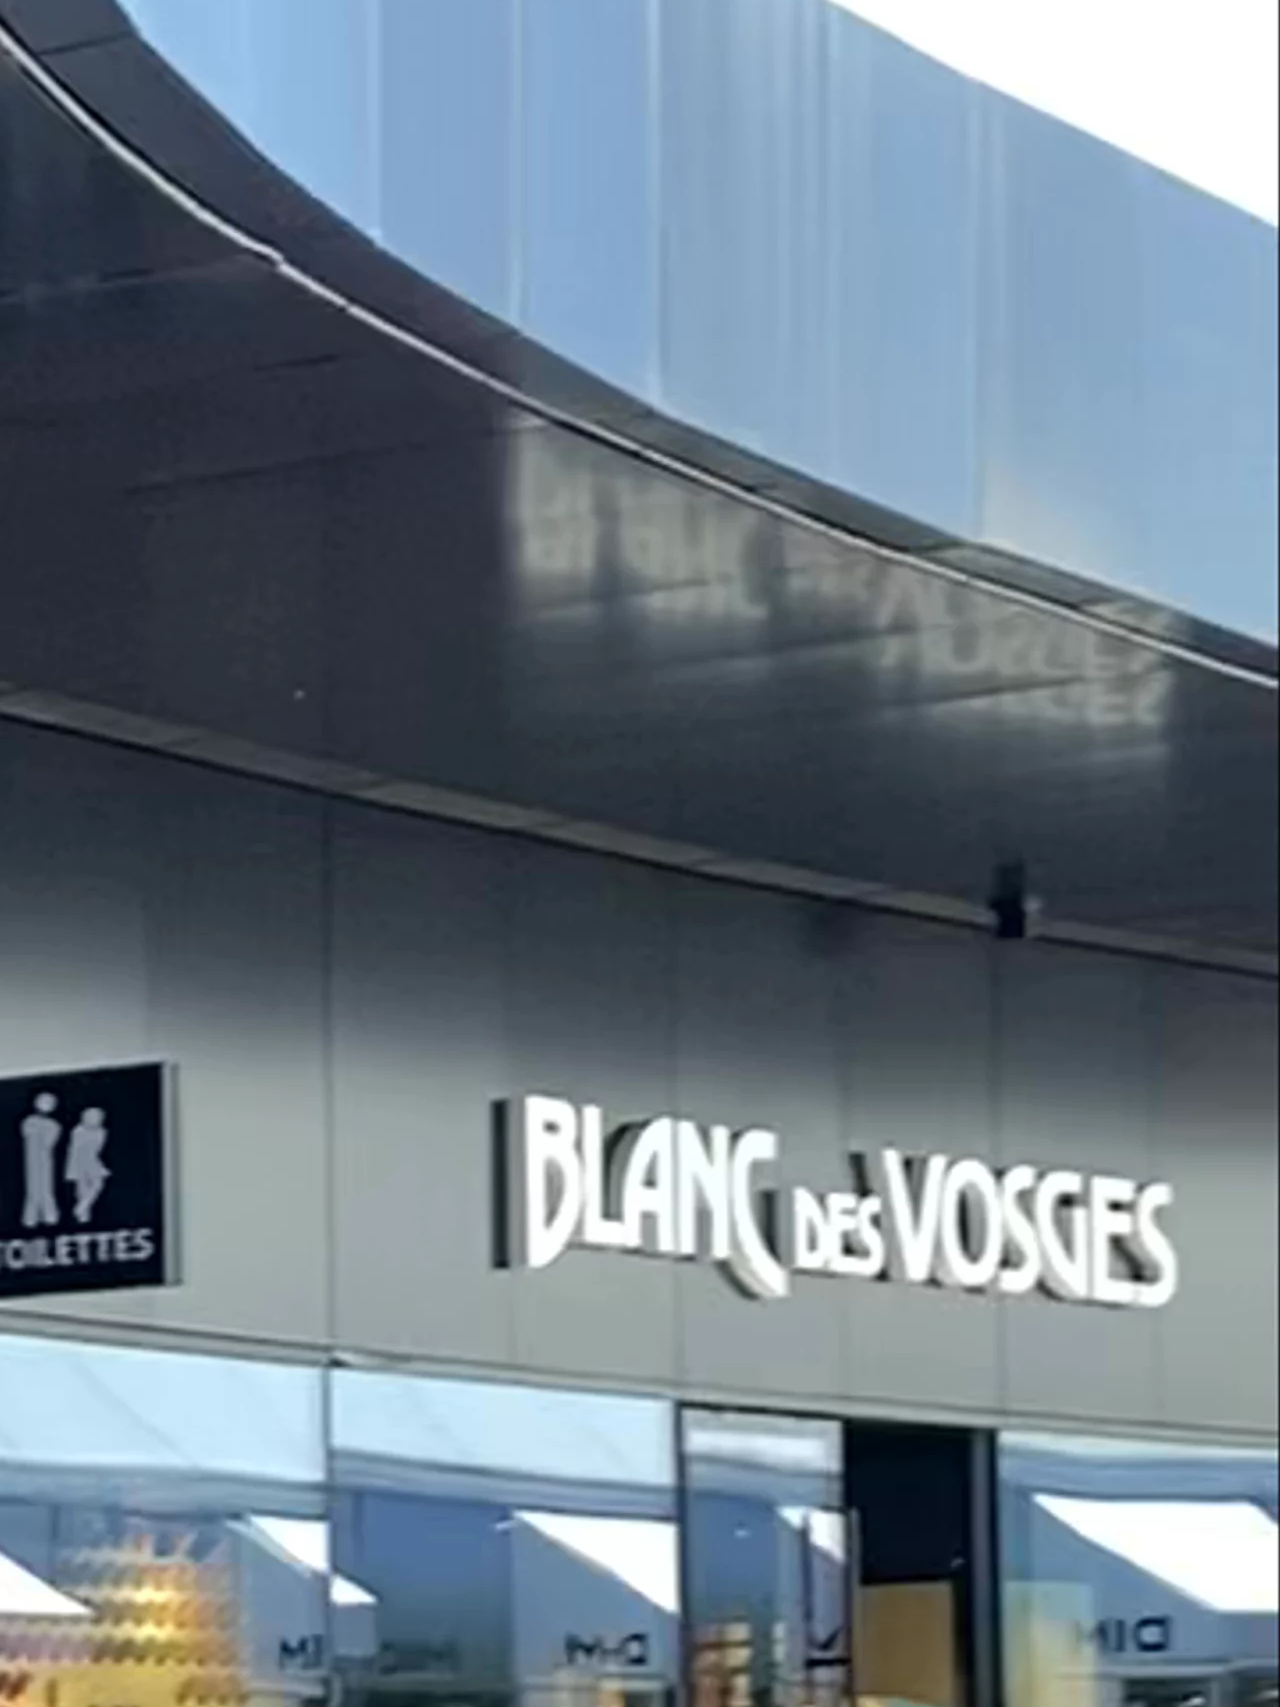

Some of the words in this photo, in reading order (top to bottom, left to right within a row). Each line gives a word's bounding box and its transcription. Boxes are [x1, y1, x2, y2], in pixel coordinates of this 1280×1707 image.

[525, 1095, 790, 1298] BLANC
[794, 1186, 885, 1277] DES
[882, 1149, 1179, 1309] VOSGES
